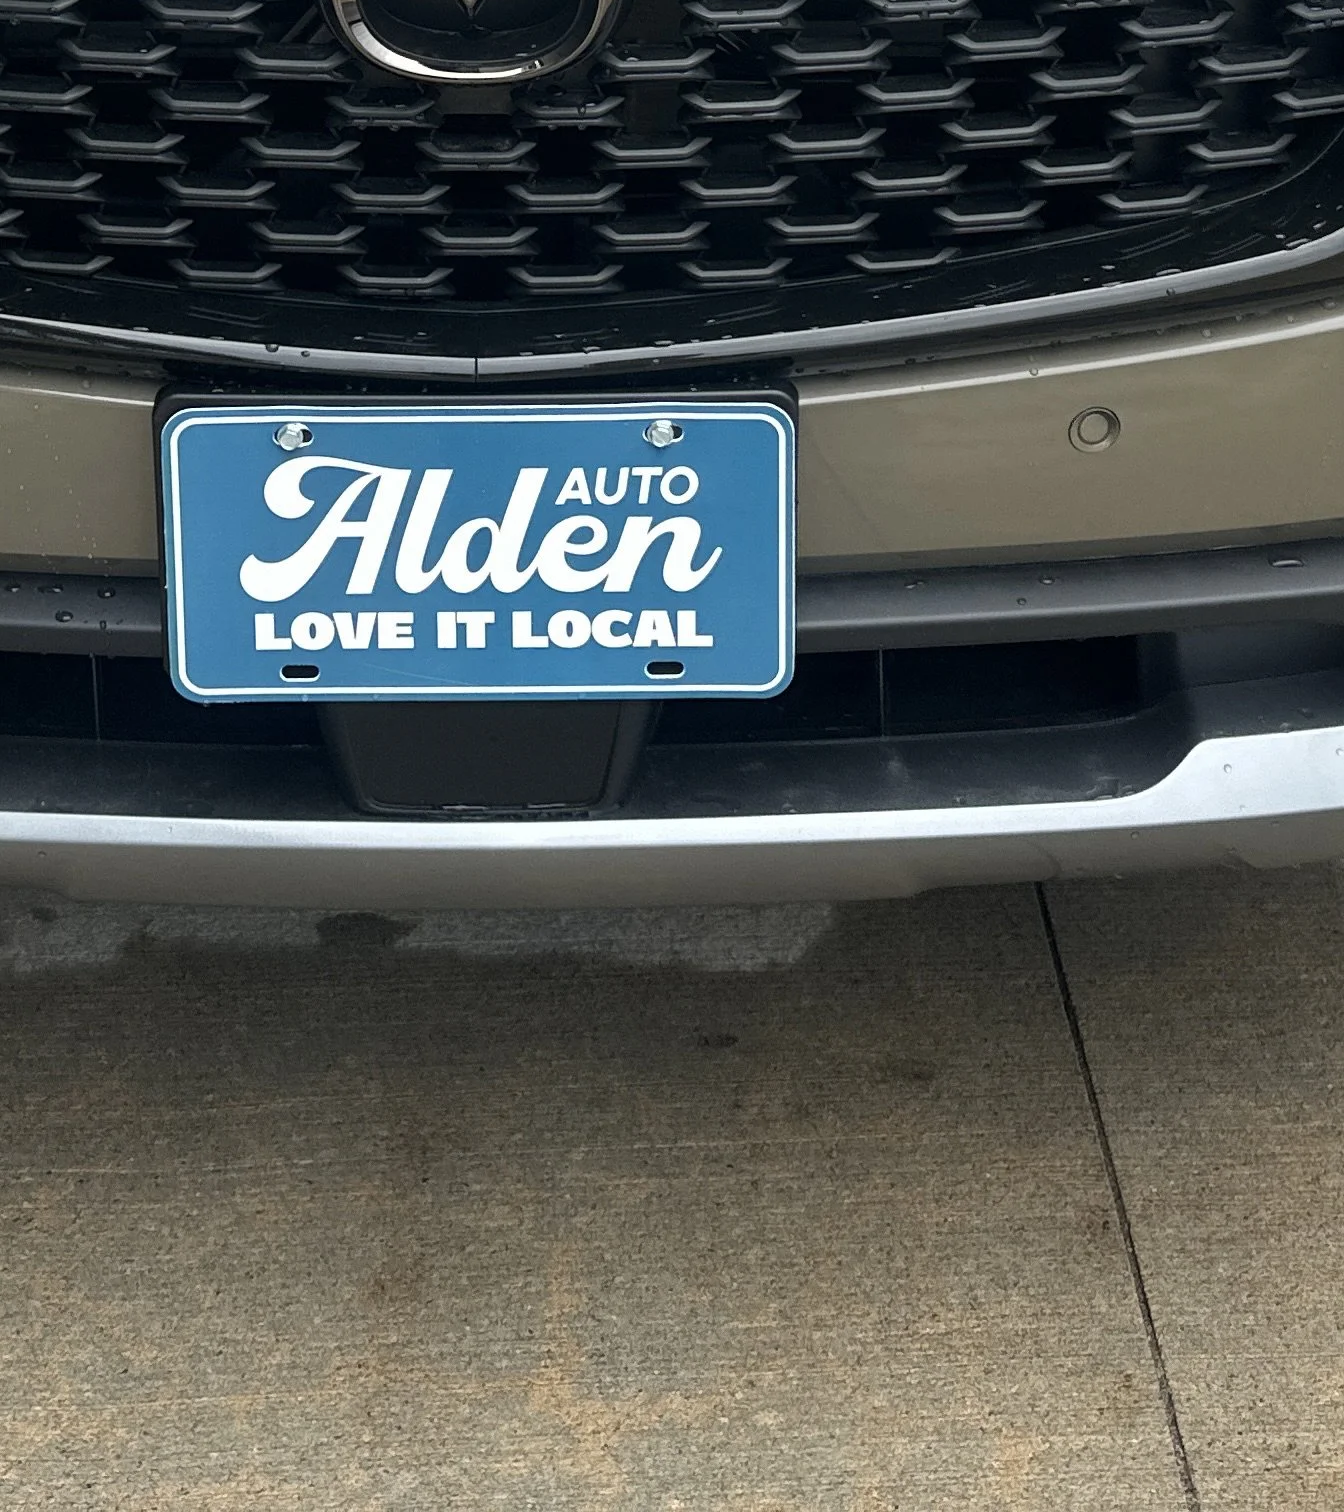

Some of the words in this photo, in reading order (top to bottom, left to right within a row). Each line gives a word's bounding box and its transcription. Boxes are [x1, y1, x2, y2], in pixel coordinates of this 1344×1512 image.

[555, 466, 699, 507] AUTO
[240, 455, 722, 602] Alden
[254, 611, 415, 651] LOVE
[436, 611, 494, 649] IT
[512, 610, 714, 648] LOCAL
